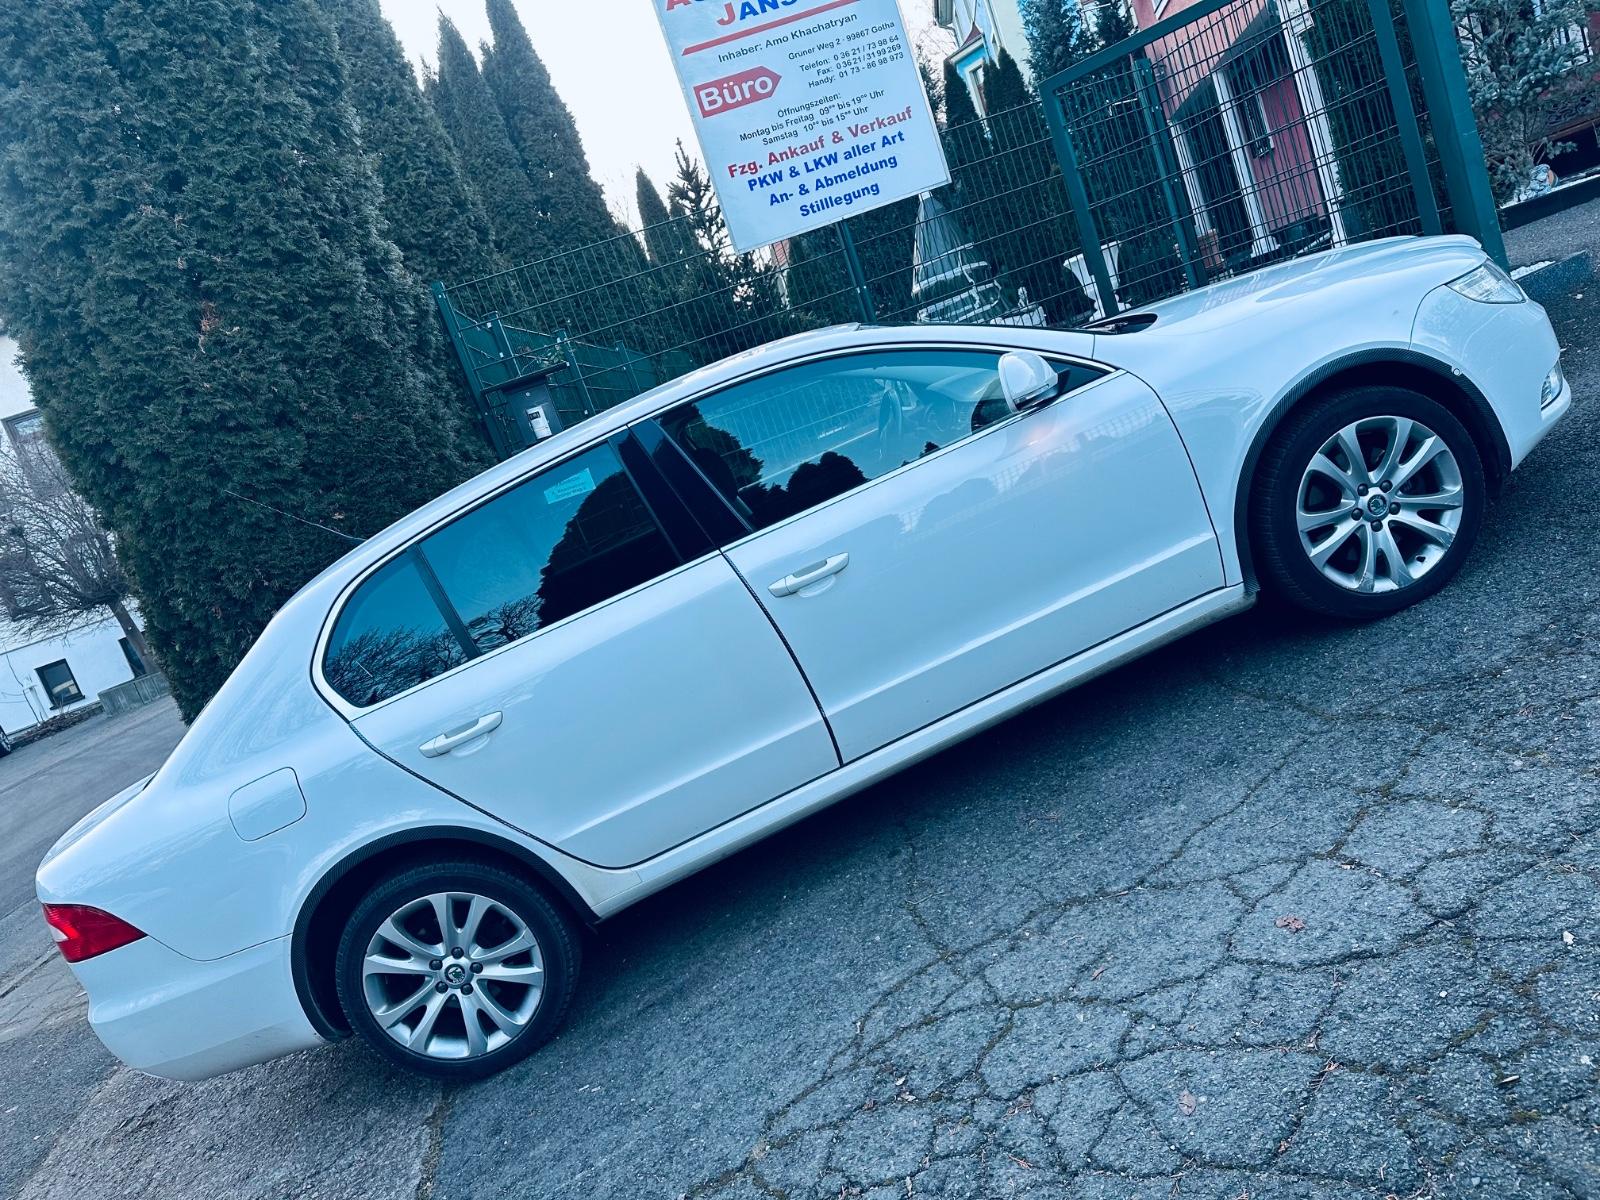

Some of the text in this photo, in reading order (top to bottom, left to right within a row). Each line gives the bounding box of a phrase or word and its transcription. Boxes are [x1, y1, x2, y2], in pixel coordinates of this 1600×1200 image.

[718, 13, 857, 62] Inhaber: Amo Khachatryan
[816, 40, 835, 52] Weg
[846, 28, 870, 42] 99867
[871, 21, 895, 33] Gotha
[800, 57, 830, 72] Telefon:
[808, 75, 836, 88] Handy:
[816, 66, 834, 76] Fax:
[699, 76, 773, 112] Büro
[739, 127, 771, 142] Montag
[772, 122, 784, 132] bis
[785, 113, 814, 127] Freitag
[837, 101, 851, 110] bis
[869, 89, 885, 100] Uhr
[762, 129, 799, 146] Samstag
[821, 117, 834, 127] bis
[853, 105, 869, 116] Uhr
[727, 106, 913, 178] Fzg. Ankauf & Verkauf
[747, 130, 905, 192] PKW & LKW aller Art
[769, 154, 898, 206] An- & Abmeldung
[799, 182, 881, 218] Stilllegung
